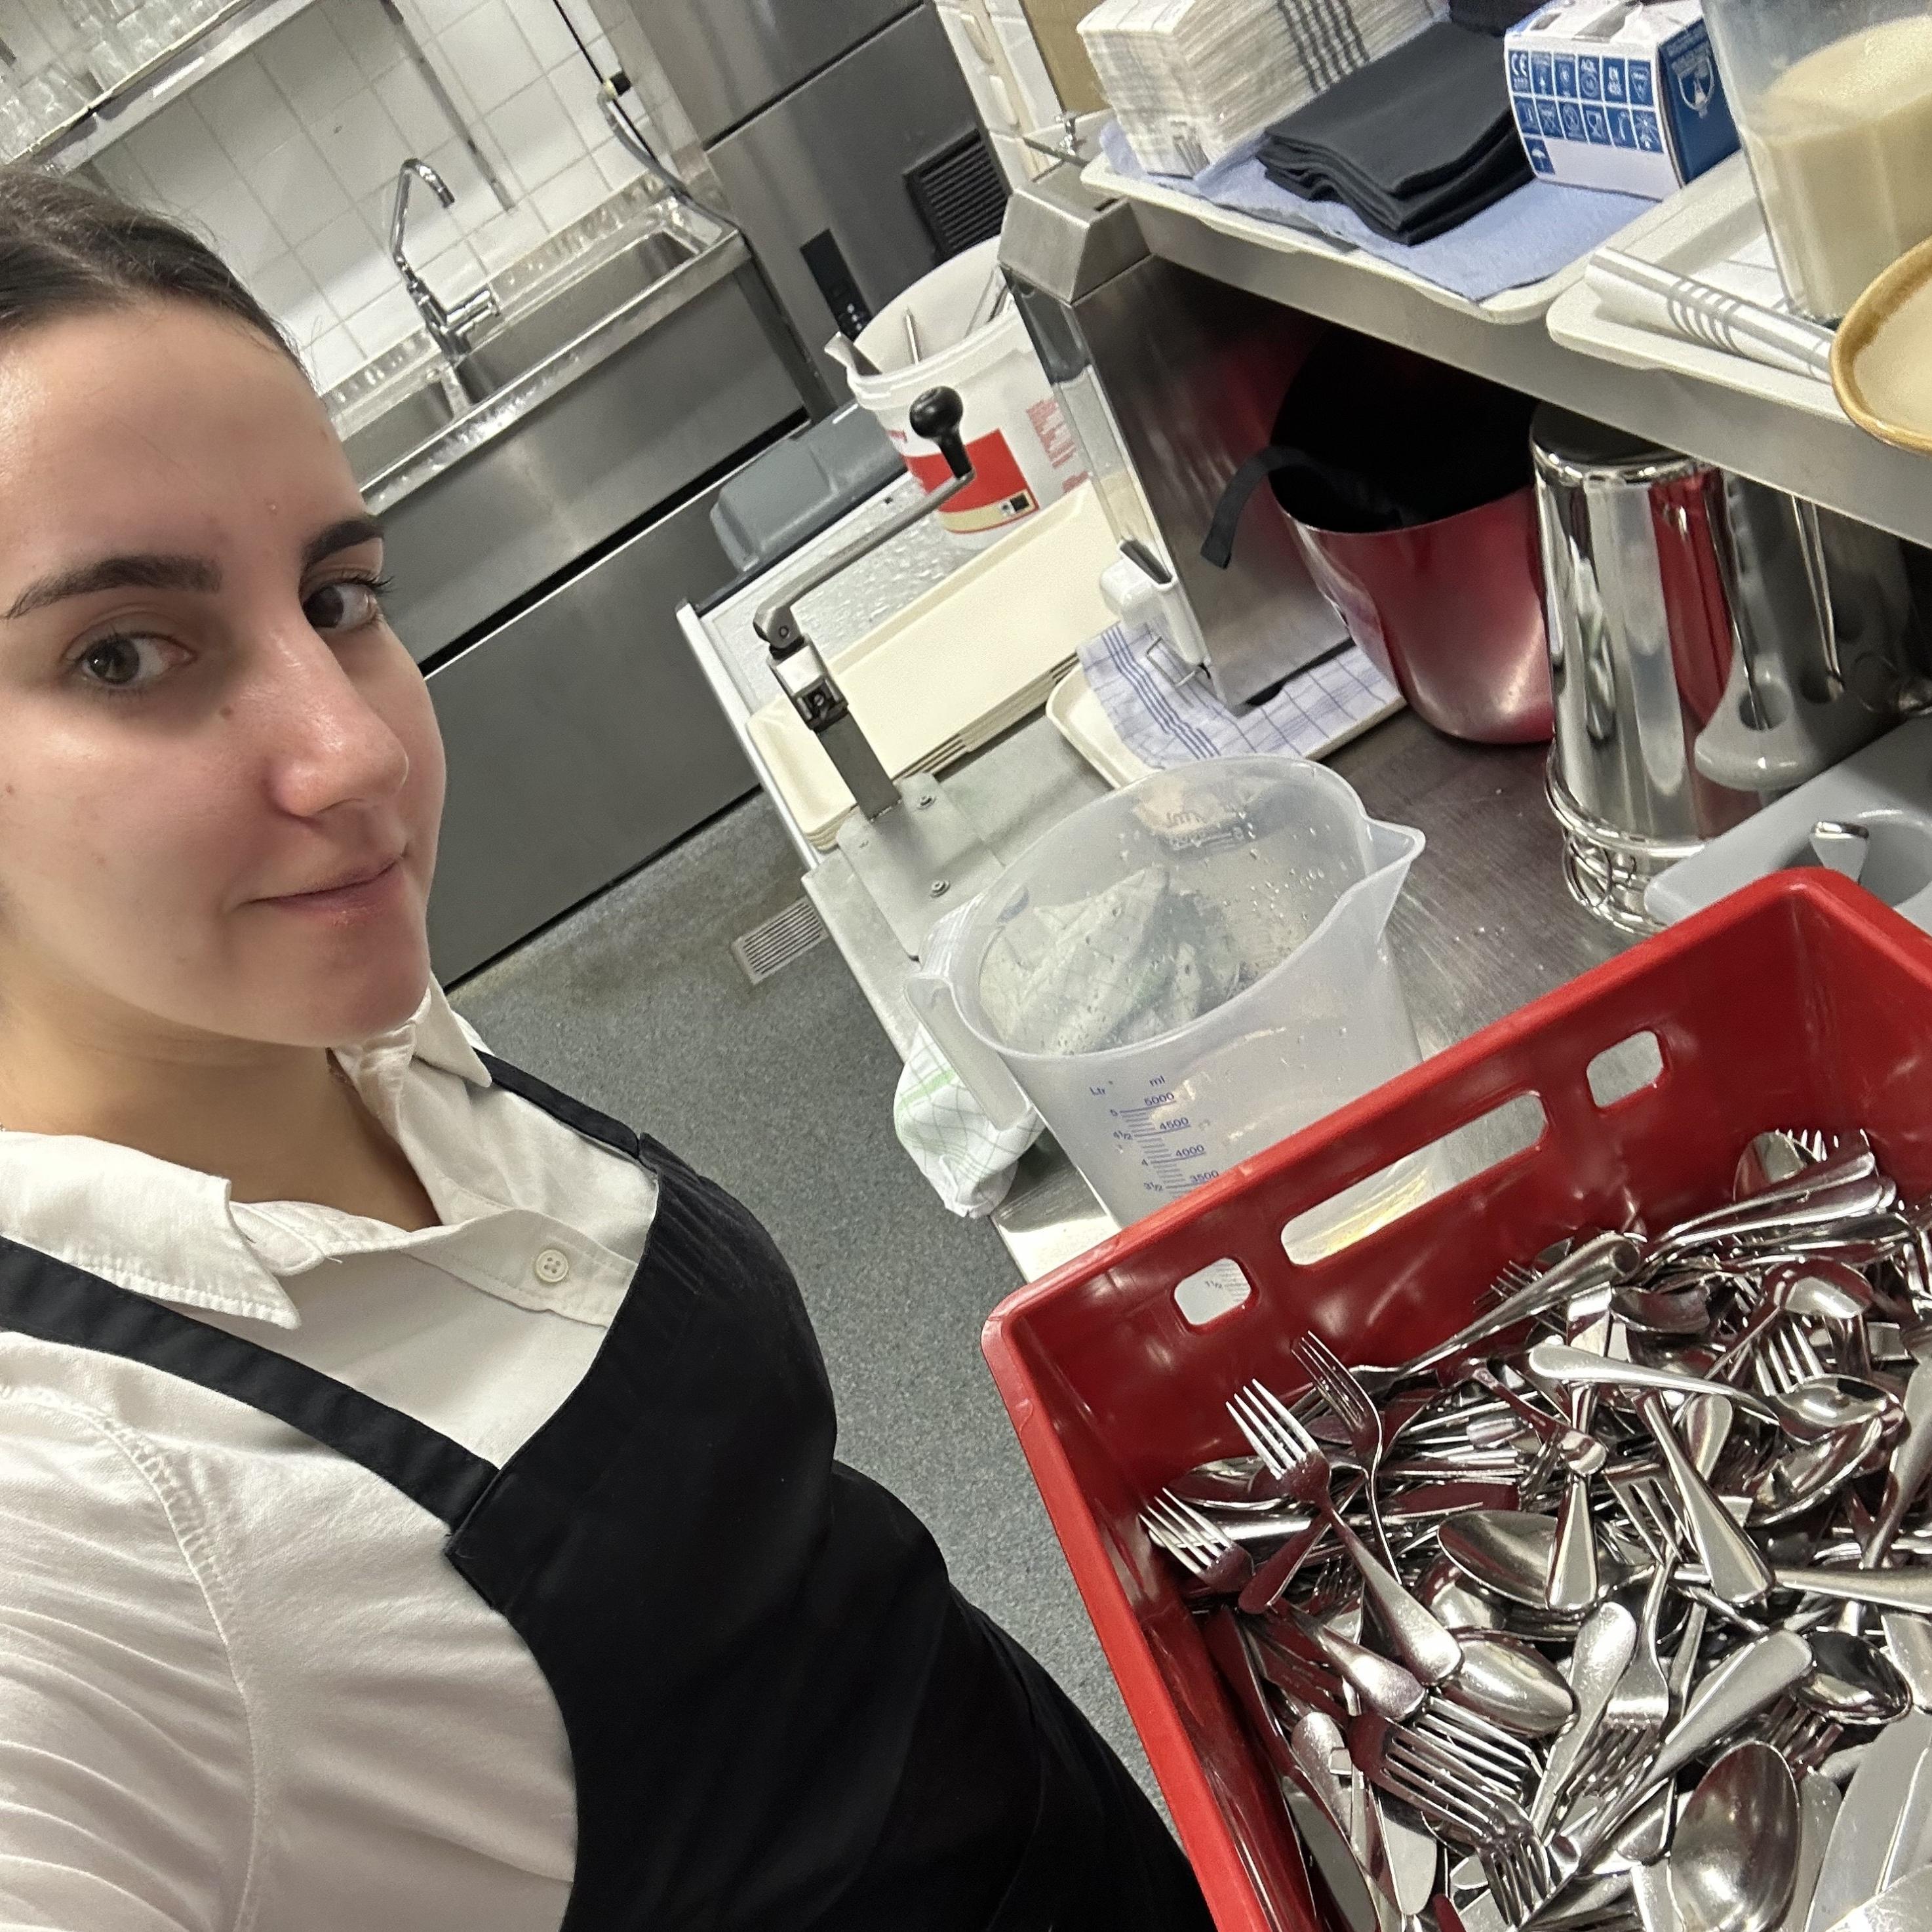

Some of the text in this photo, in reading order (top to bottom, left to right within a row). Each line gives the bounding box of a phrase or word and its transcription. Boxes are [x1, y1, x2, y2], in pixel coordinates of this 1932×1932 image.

[1149, 1075, 1165, 1086] ml
[1143, 1092, 1175, 1106] 5000
[1159, 1116, 1189, 1130] 4500
[1175, 1144, 1205, 1157] 4000
[1189, 1170, 1219, 1183] 3500
